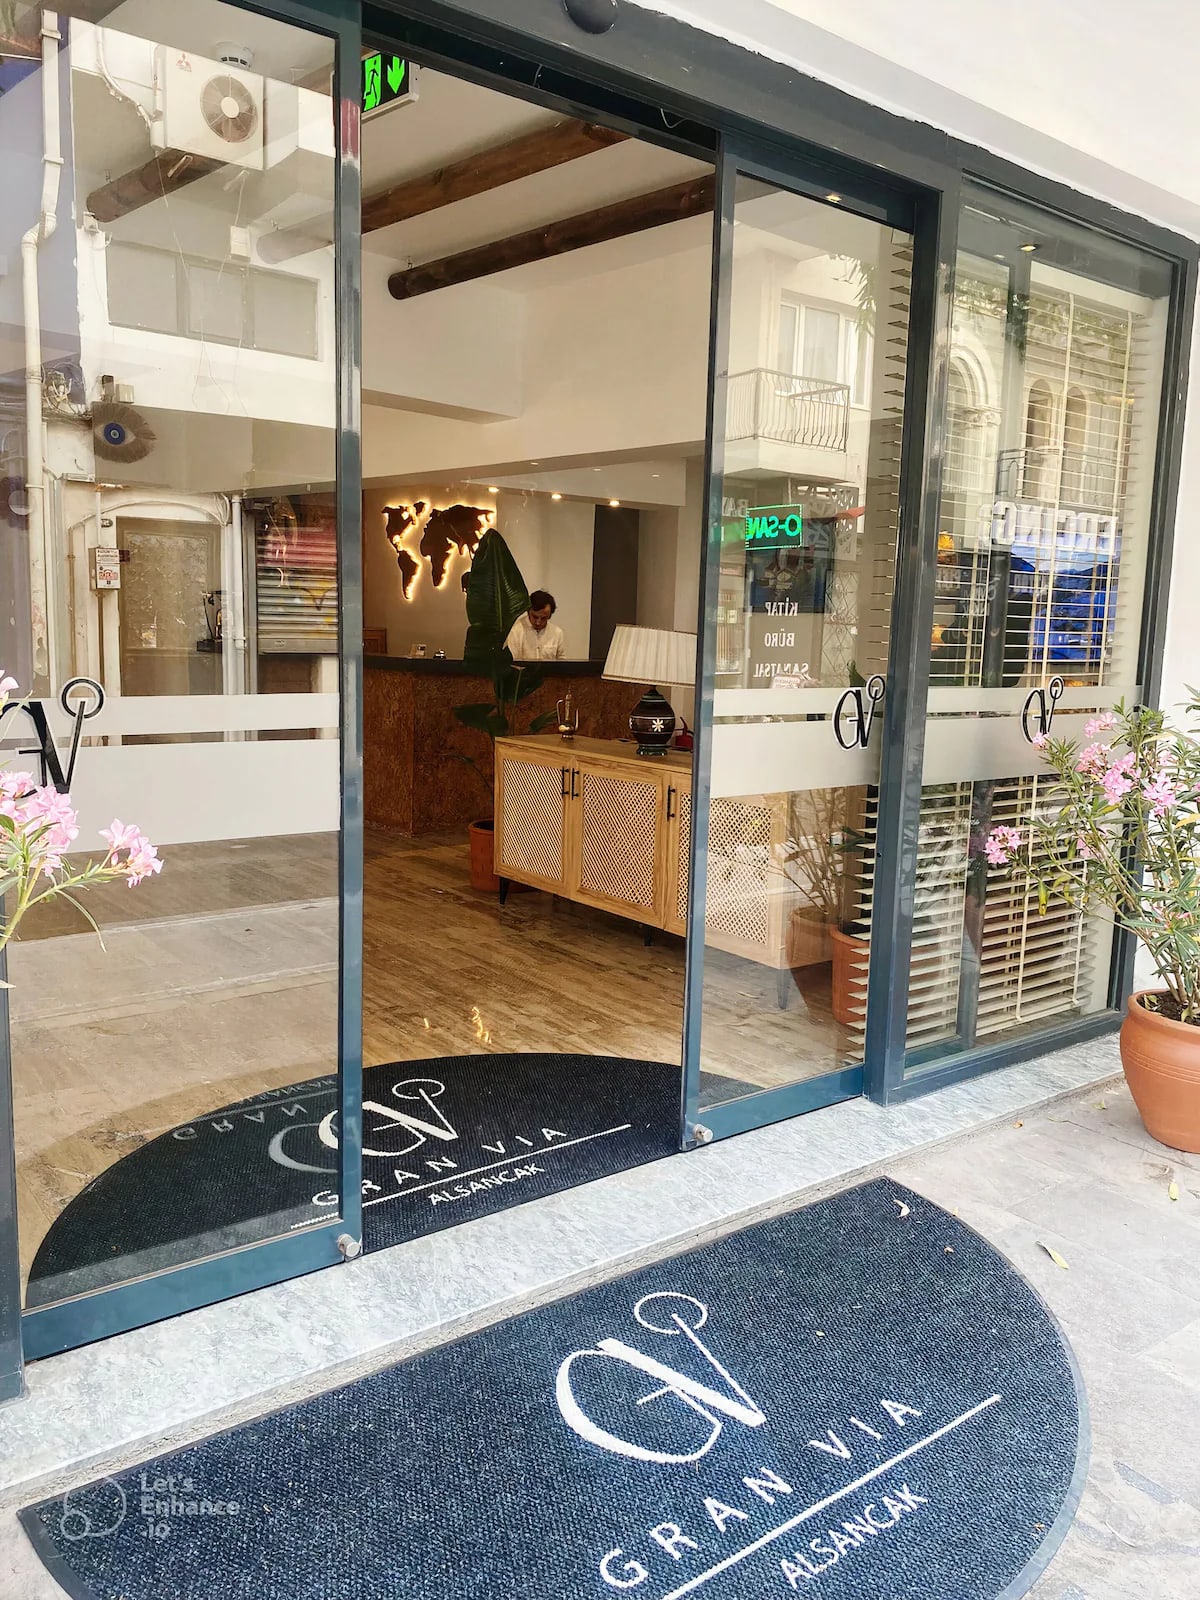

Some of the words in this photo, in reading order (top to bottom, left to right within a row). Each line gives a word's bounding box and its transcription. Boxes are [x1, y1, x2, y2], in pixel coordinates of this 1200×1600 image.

[482, 1126, 567, 1154] VIA
[428, 1162, 545, 1206] ALSANCAK
[599, 1466, 794, 1589] GRAN
[809, 1399, 923, 1459] VIA
[779, 1483, 927, 1590] ALSANCAK
